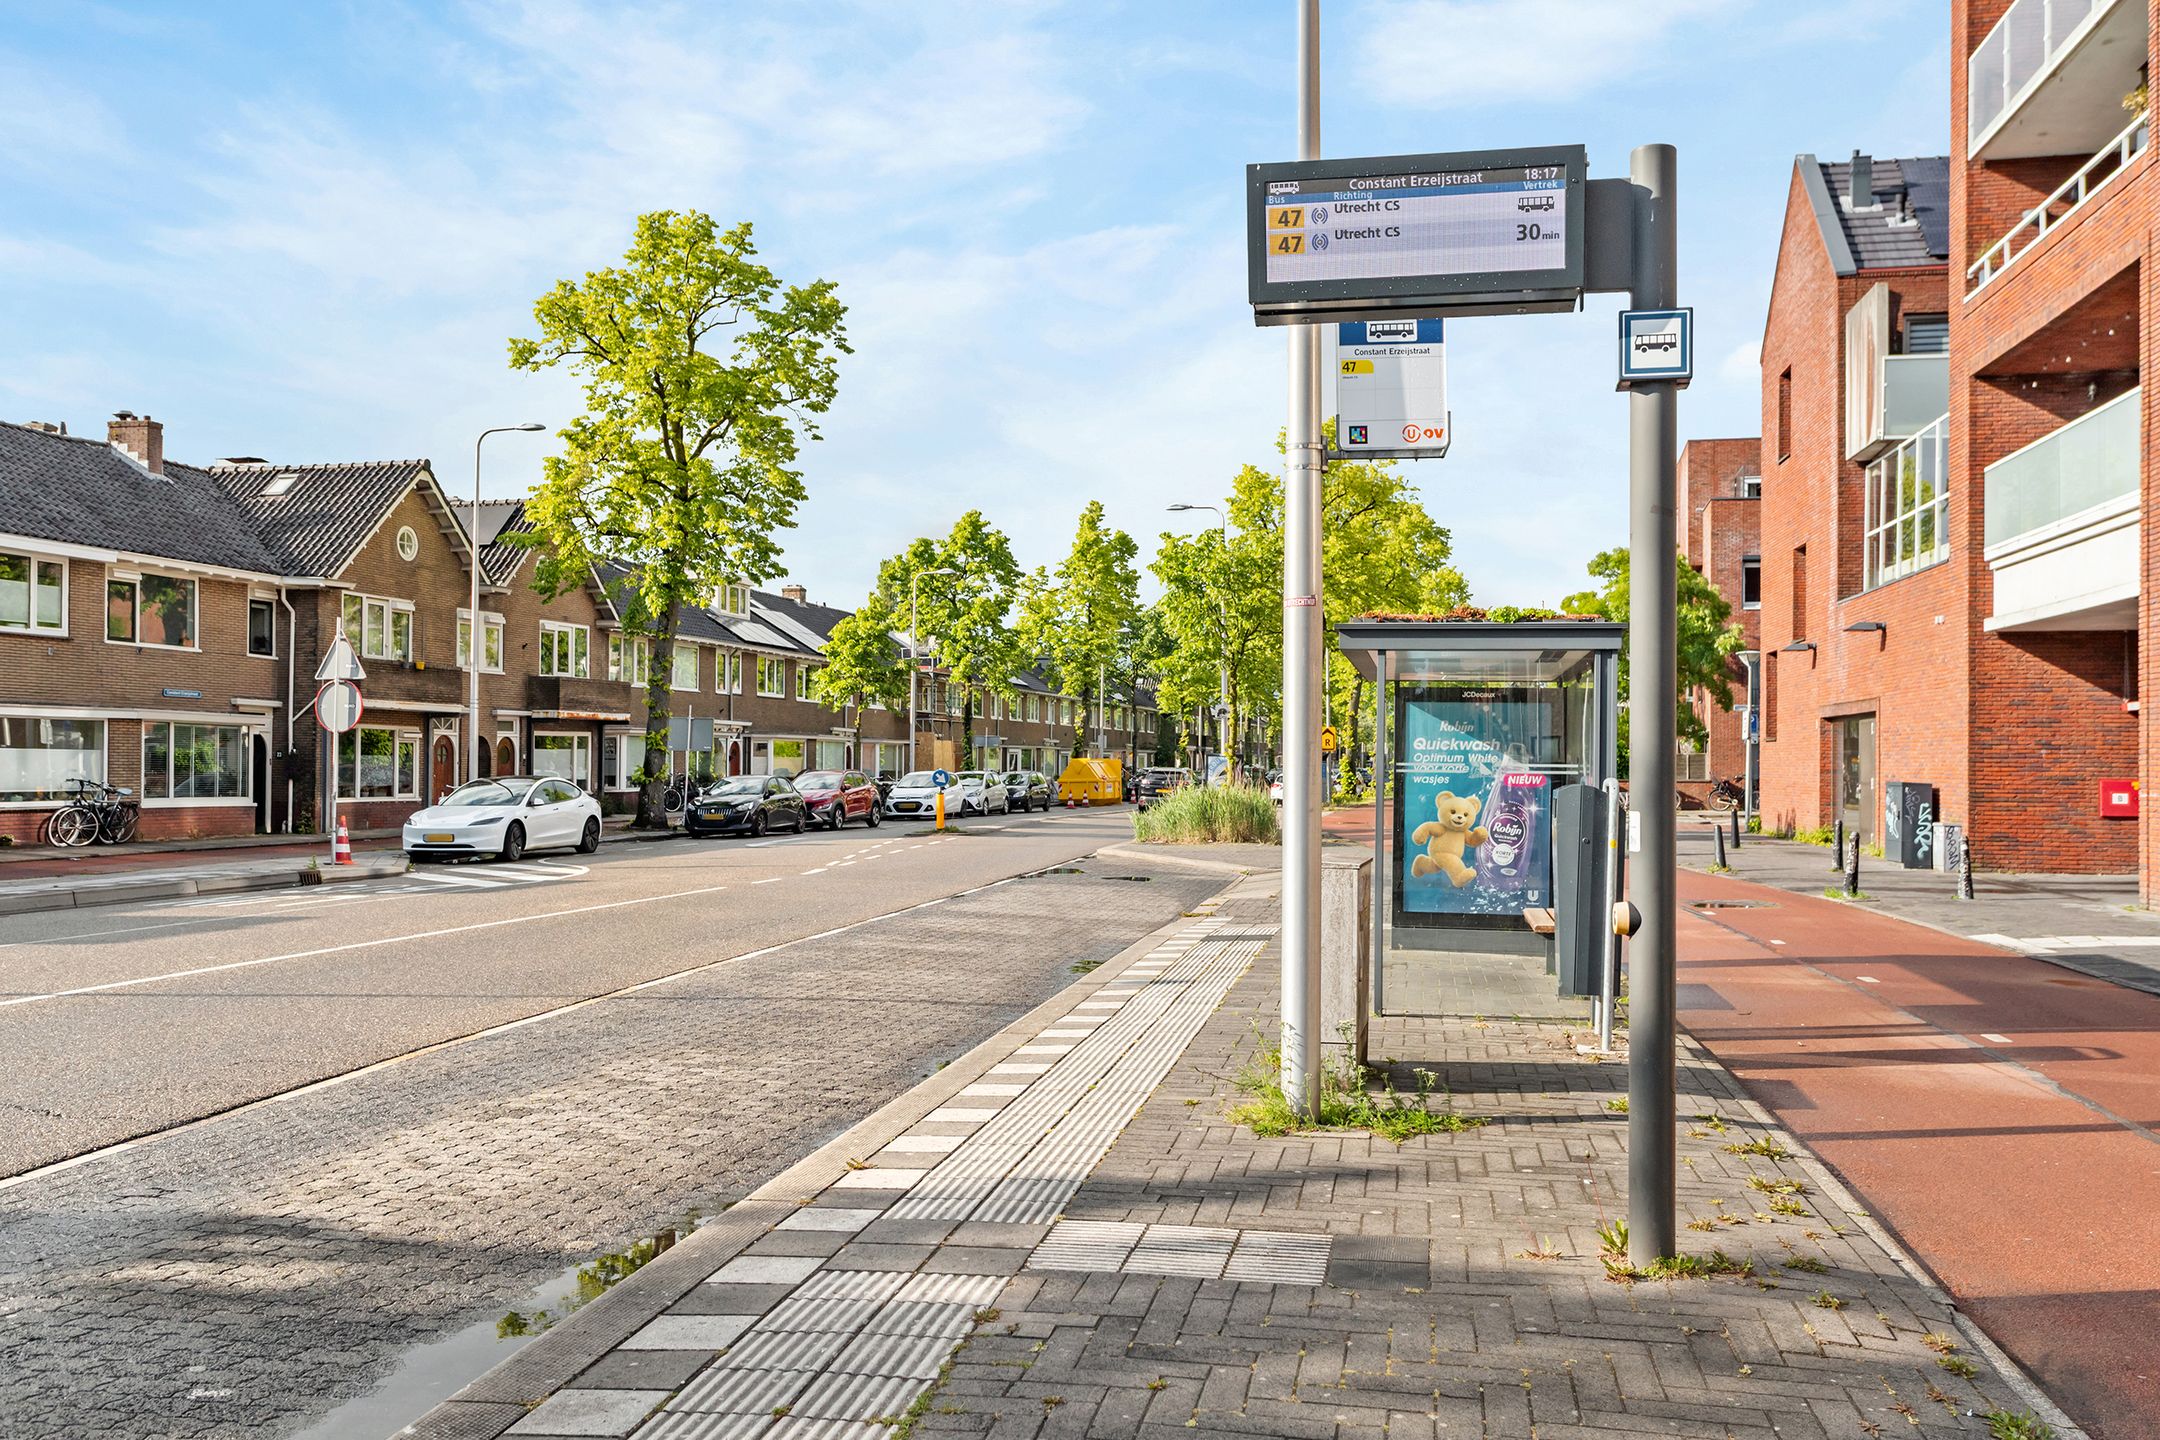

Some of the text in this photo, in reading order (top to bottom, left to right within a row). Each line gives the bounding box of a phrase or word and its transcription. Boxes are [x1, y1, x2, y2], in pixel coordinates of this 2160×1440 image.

[1524, 167, 1558, 180] 18:17
[1349, 172, 1483, 190] Constant Erzeijstraat
[1523, 180, 1558, 190] Vertrek
[1268, 195, 1285, 204] Bus
[1333, 191, 1373, 201] Richting
[1334, 200, 1400, 213] Utrecht CS
[1278, 209, 1302, 227] 47
[1334, 226, 1400, 240] Utrecht CS
[1516, 223, 1560, 241] 30 min
[1278, 236, 1302, 253] 47
[1354, 347, 1430, 356] Constant Erzeijstraat
[1342, 361, 1356, 373] 47
[1439, 720, 1474, 734] Robijn
[1413, 737, 1500, 751] Quickwash
[1413, 753, 1498, 764] Optimum White
[1413, 774, 1450, 785] wasjes
[1507, 775, 1543, 785] NIEUW
[1492, 822, 1522, 836] Robijn
